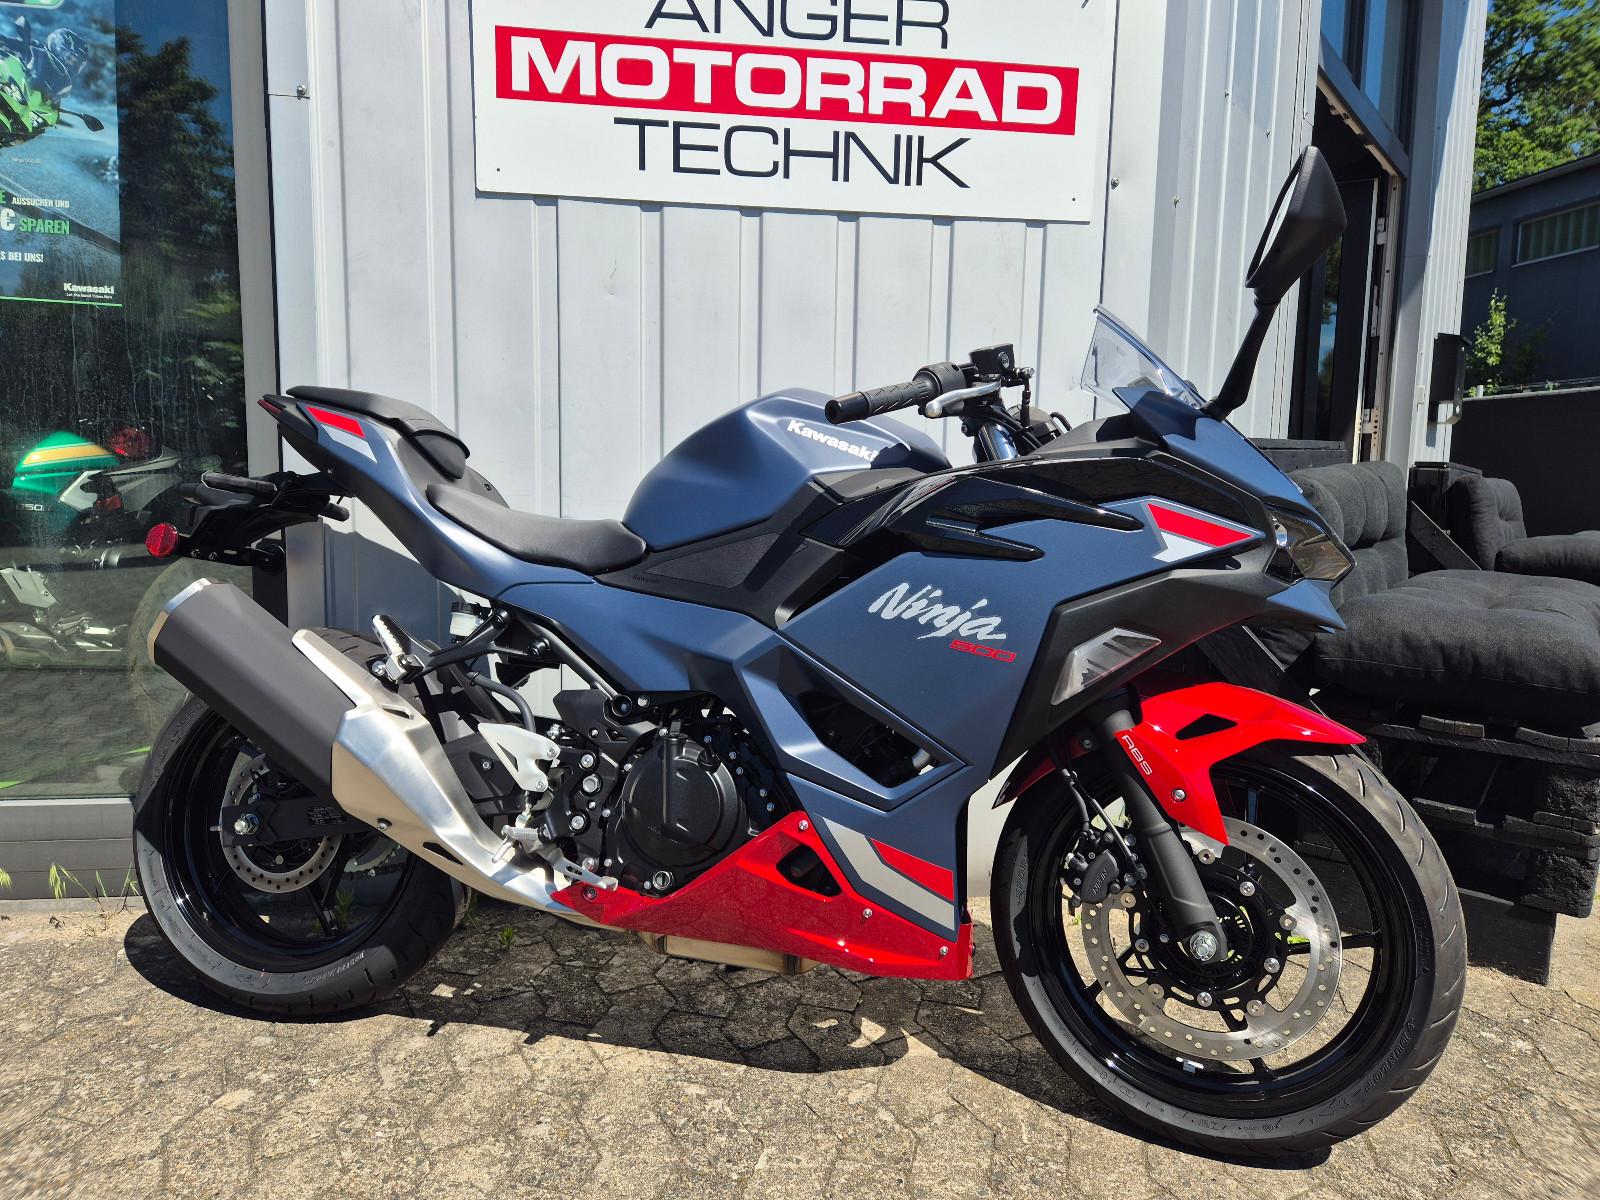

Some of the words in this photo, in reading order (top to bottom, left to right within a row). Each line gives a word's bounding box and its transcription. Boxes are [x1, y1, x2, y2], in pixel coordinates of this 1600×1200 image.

[644, 0, 950, 49] ANGER
[510, 35, 1063, 125] MOTORRAD
[613, 117, 972, 189] TECHNIK
[12, 196, 54, 207] AUSSUCHEN
[55, 200, 70, 208] UND
[20, 218, 70, 235] SPAREN
[8, 252, 22, 261] BEI
[24, 253, 44, 263] UNS!
[63, 282, 115, 294] Kawasaki
[786, 419, 880, 461] Kawasaki
[868, 582, 1007, 640] Ninja
[949, 639, 1017, 663] 500
[1121, 734, 1153, 775] ABS
